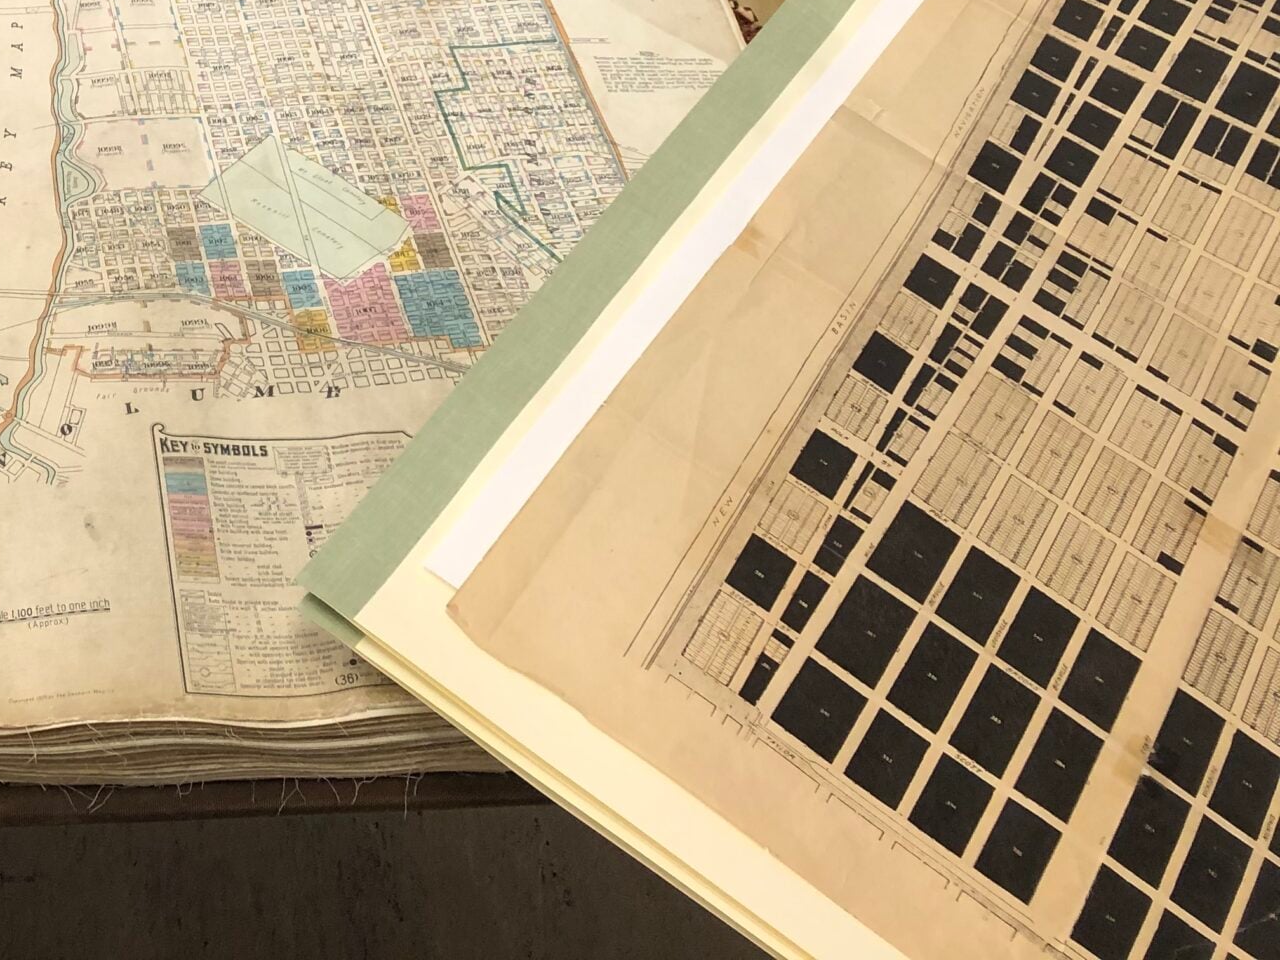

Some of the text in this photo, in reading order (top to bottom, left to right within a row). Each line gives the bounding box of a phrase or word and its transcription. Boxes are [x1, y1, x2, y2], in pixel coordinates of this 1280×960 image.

[160, 437, 268, 457] KEY SYMBOLS
[712, 496, 734, 528] NEW
[35, 603, 54, 615] feet
[57, 603, 66, 612] to
[69, 600, 86, 611] one
[89, 598, 110, 609] inch
[766, 736, 797, 760] TAYLOR
[954, 753, 983, 775] SCOTT
